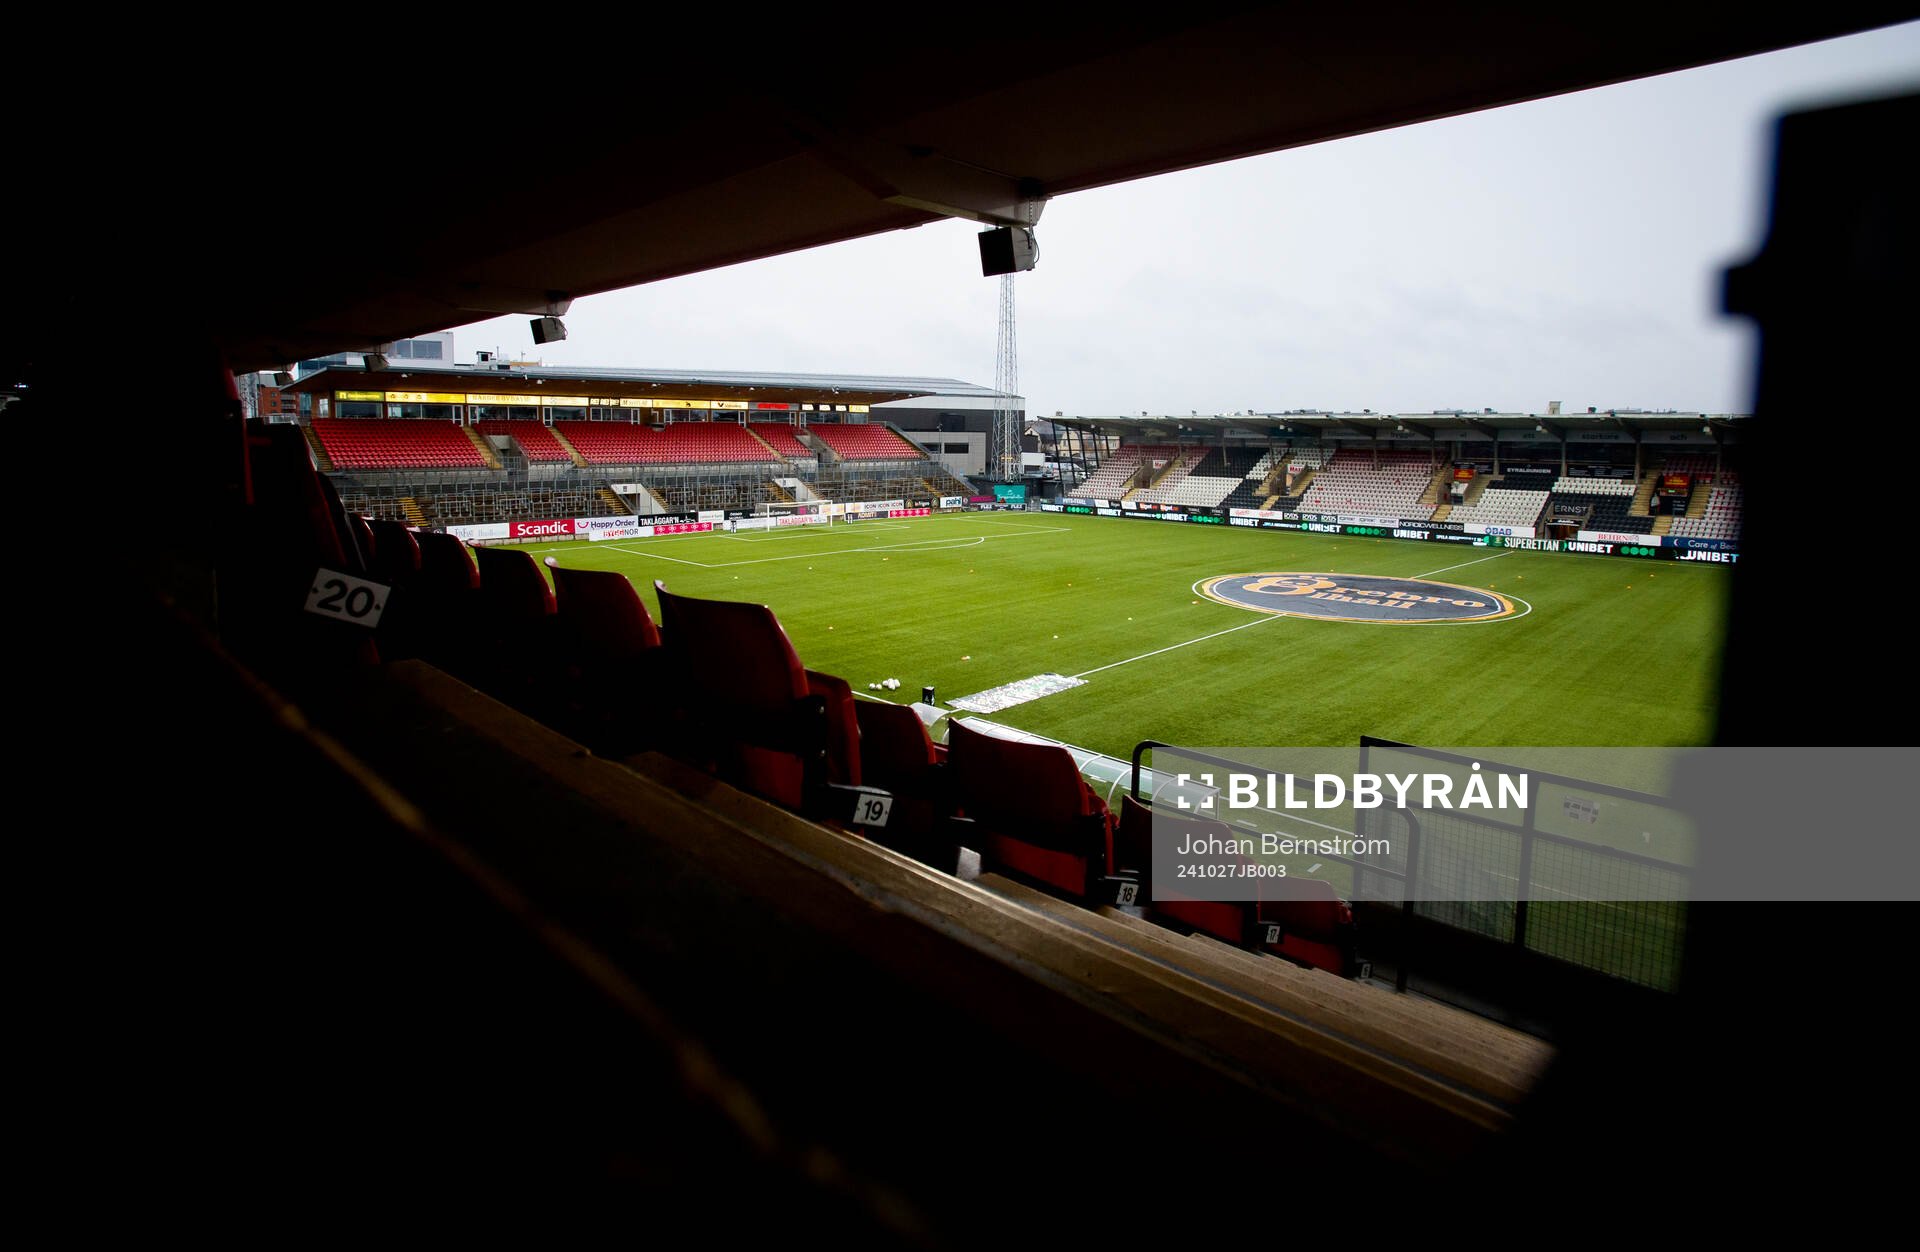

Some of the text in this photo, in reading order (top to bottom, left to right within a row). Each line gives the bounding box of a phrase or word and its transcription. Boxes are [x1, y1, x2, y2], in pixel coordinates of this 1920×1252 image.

[1042, 504, 1064, 512] UNIBET
[1097, 508, 1122, 517] UNIBET
[1555, 502, 1588, 514] ERNST
[1161, 513, 1188, 522] UNIBET
[1230, 517, 1260, 527] UNIBET
[517, 521, 570, 536] Scandic
[591, 519, 635, 529] Happy Order
[1393, 529, 1431, 540] UNIBET
[1504, 536, 1559, 551] SUPERETTAN
[1568, 541, 1614, 554] UNIBET
[1687, 539, 1709, 549] Care
[1687, 550, 1740, 563] UNIBET
[316, 578, 375, 618] 20
[865, 800, 884, 821] 19
[1122, 886, 1135, 902] 18
